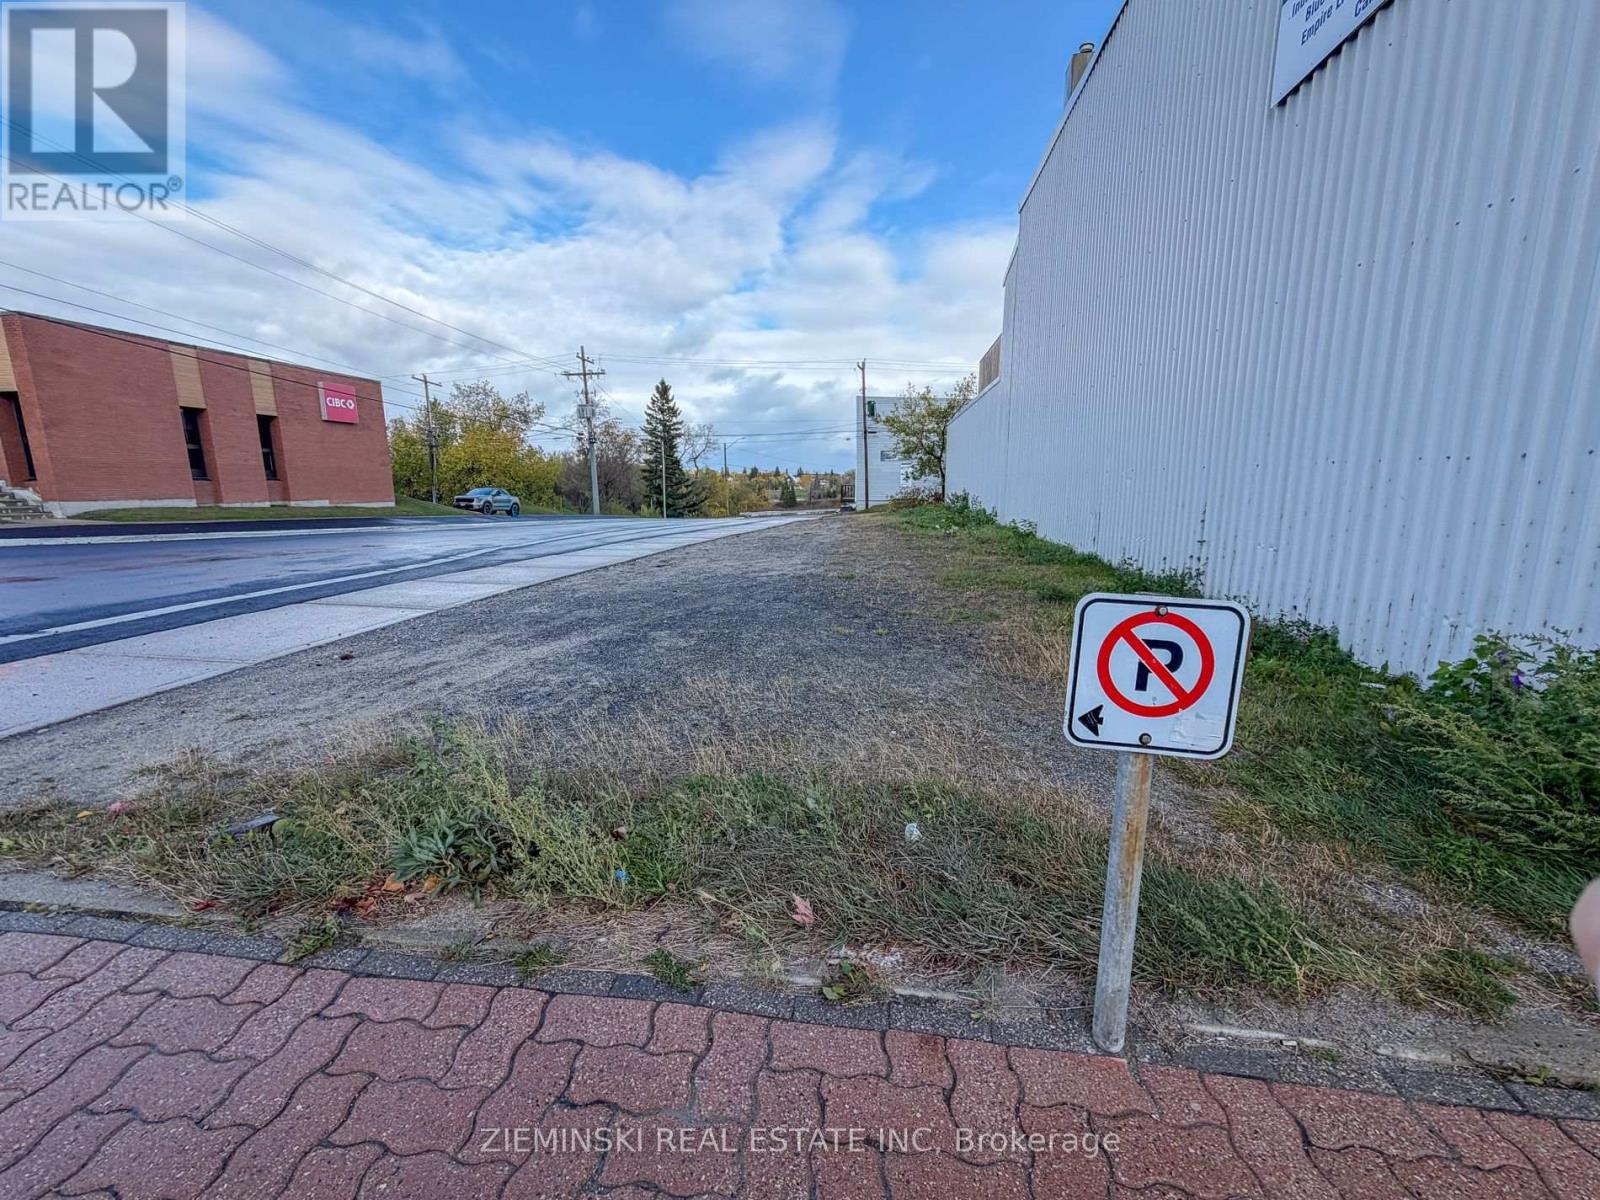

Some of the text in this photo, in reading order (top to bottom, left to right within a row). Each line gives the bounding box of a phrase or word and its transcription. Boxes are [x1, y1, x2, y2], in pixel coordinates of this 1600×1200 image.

[1301, 4, 1333, 46] Empire
[326, 397, 347, 408] CIBC
[1135, 638, 1184, 692] P
